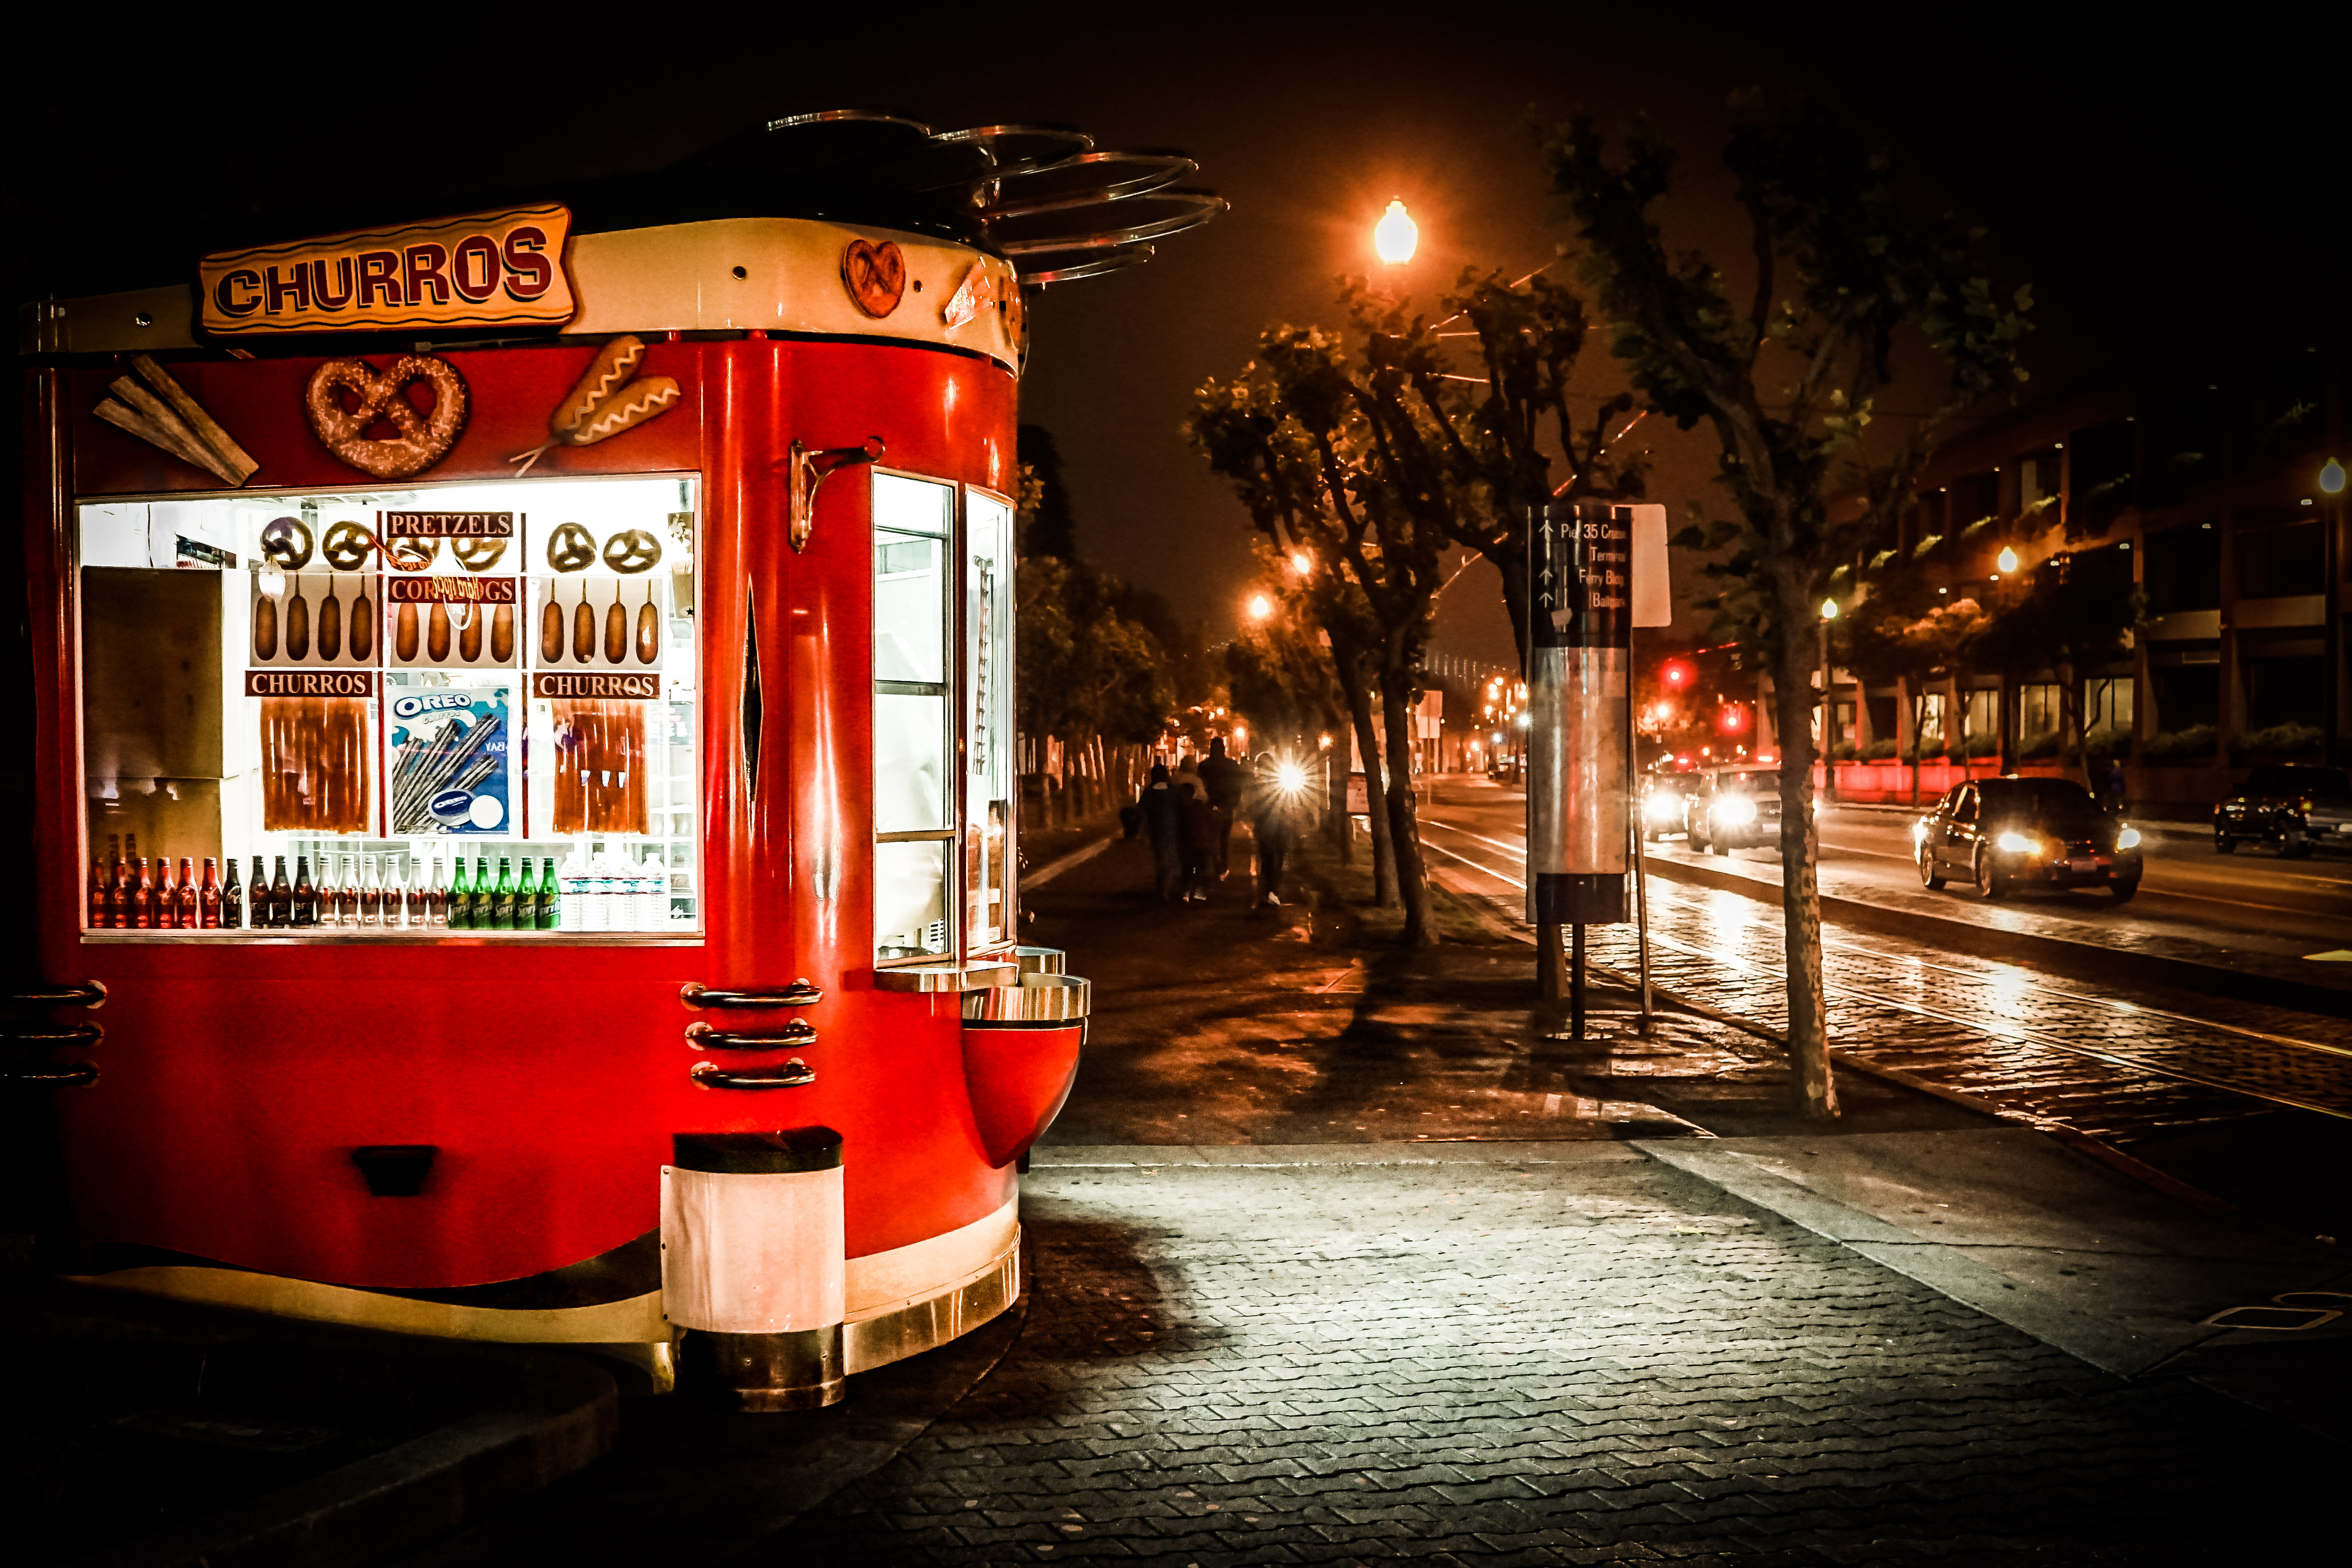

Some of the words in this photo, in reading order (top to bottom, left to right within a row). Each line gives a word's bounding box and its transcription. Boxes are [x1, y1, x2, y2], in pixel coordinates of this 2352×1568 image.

[214, 226, 553, 317] CHURROS
[391, 515, 510, 534] PRETZELS
[1561, 524, 1581, 539] Pie
[1584, 524, 1598, 539] 35
[251, 674, 366, 694] CHURROS
[540, 676, 654, 696] CHURROS
[395, 694, 471, 718] OREO
[434, 796, 468, 809] OREO
